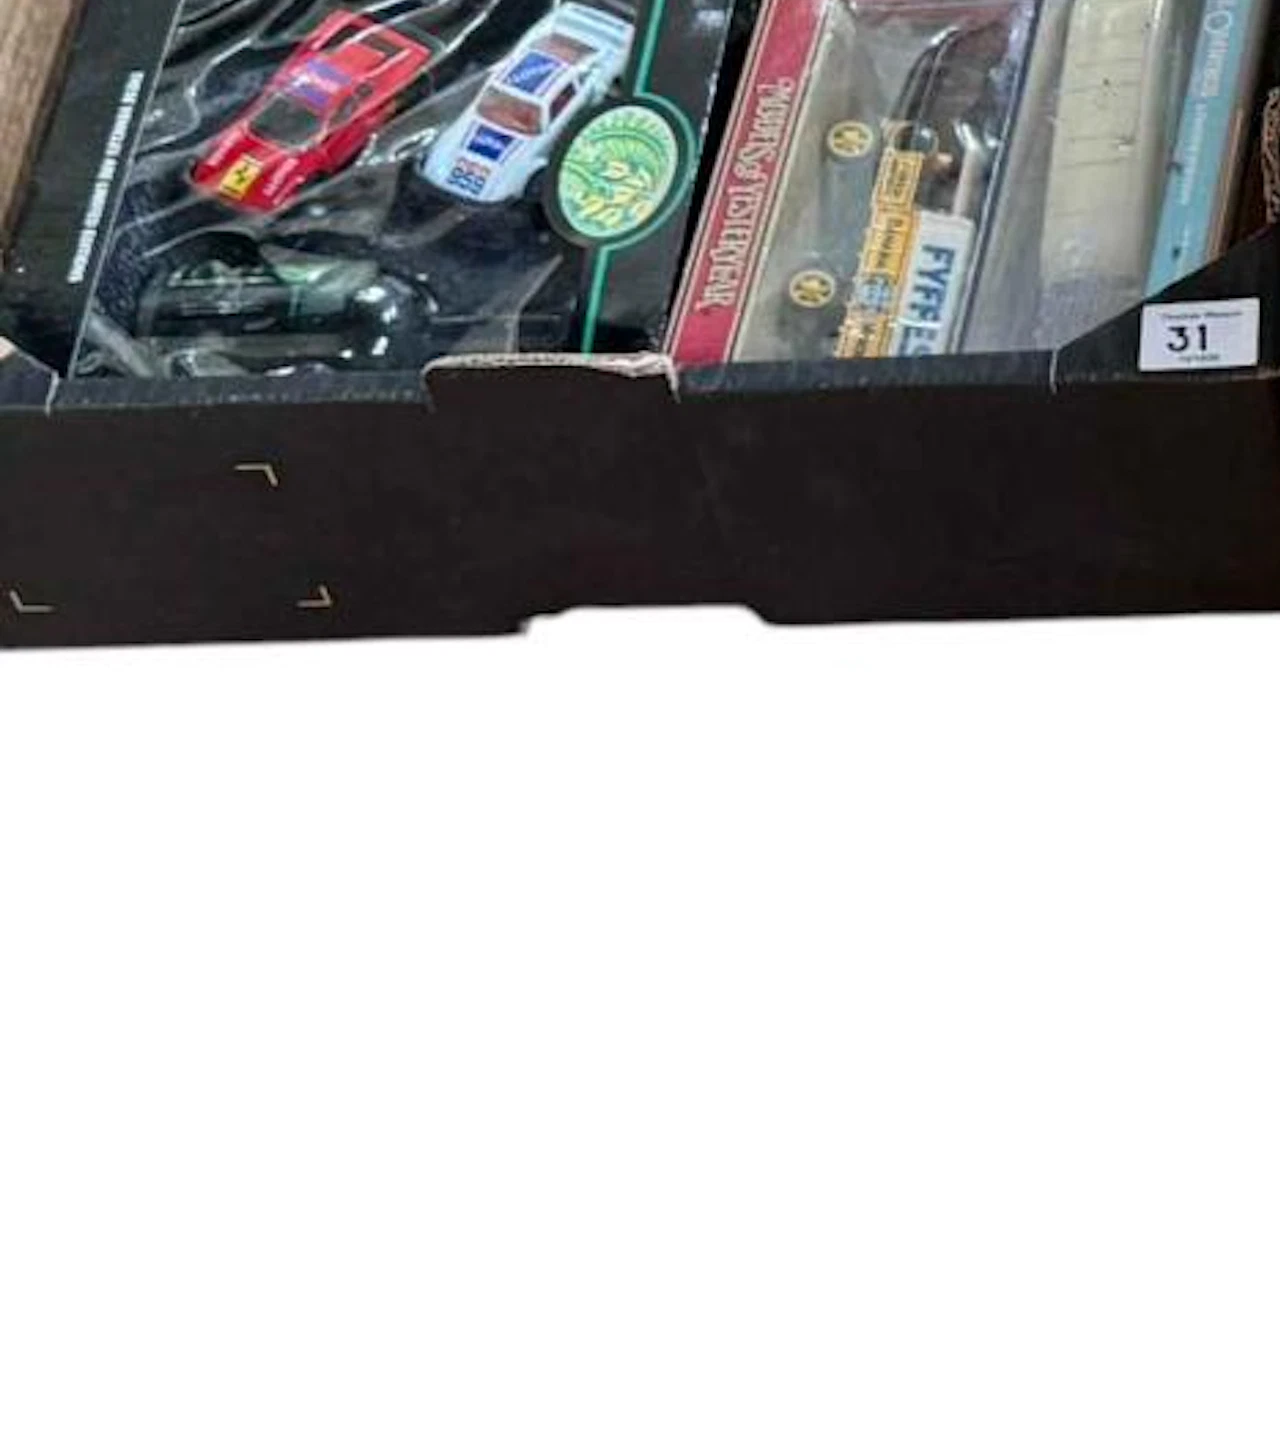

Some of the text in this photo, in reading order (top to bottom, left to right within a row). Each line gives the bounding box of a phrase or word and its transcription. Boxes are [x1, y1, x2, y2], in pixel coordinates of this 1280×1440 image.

[752, 77, 796, 160] MODELS
[696, 170, 768, 312] YESTERYEAR
[1166, 323, 1208, 352] 31
